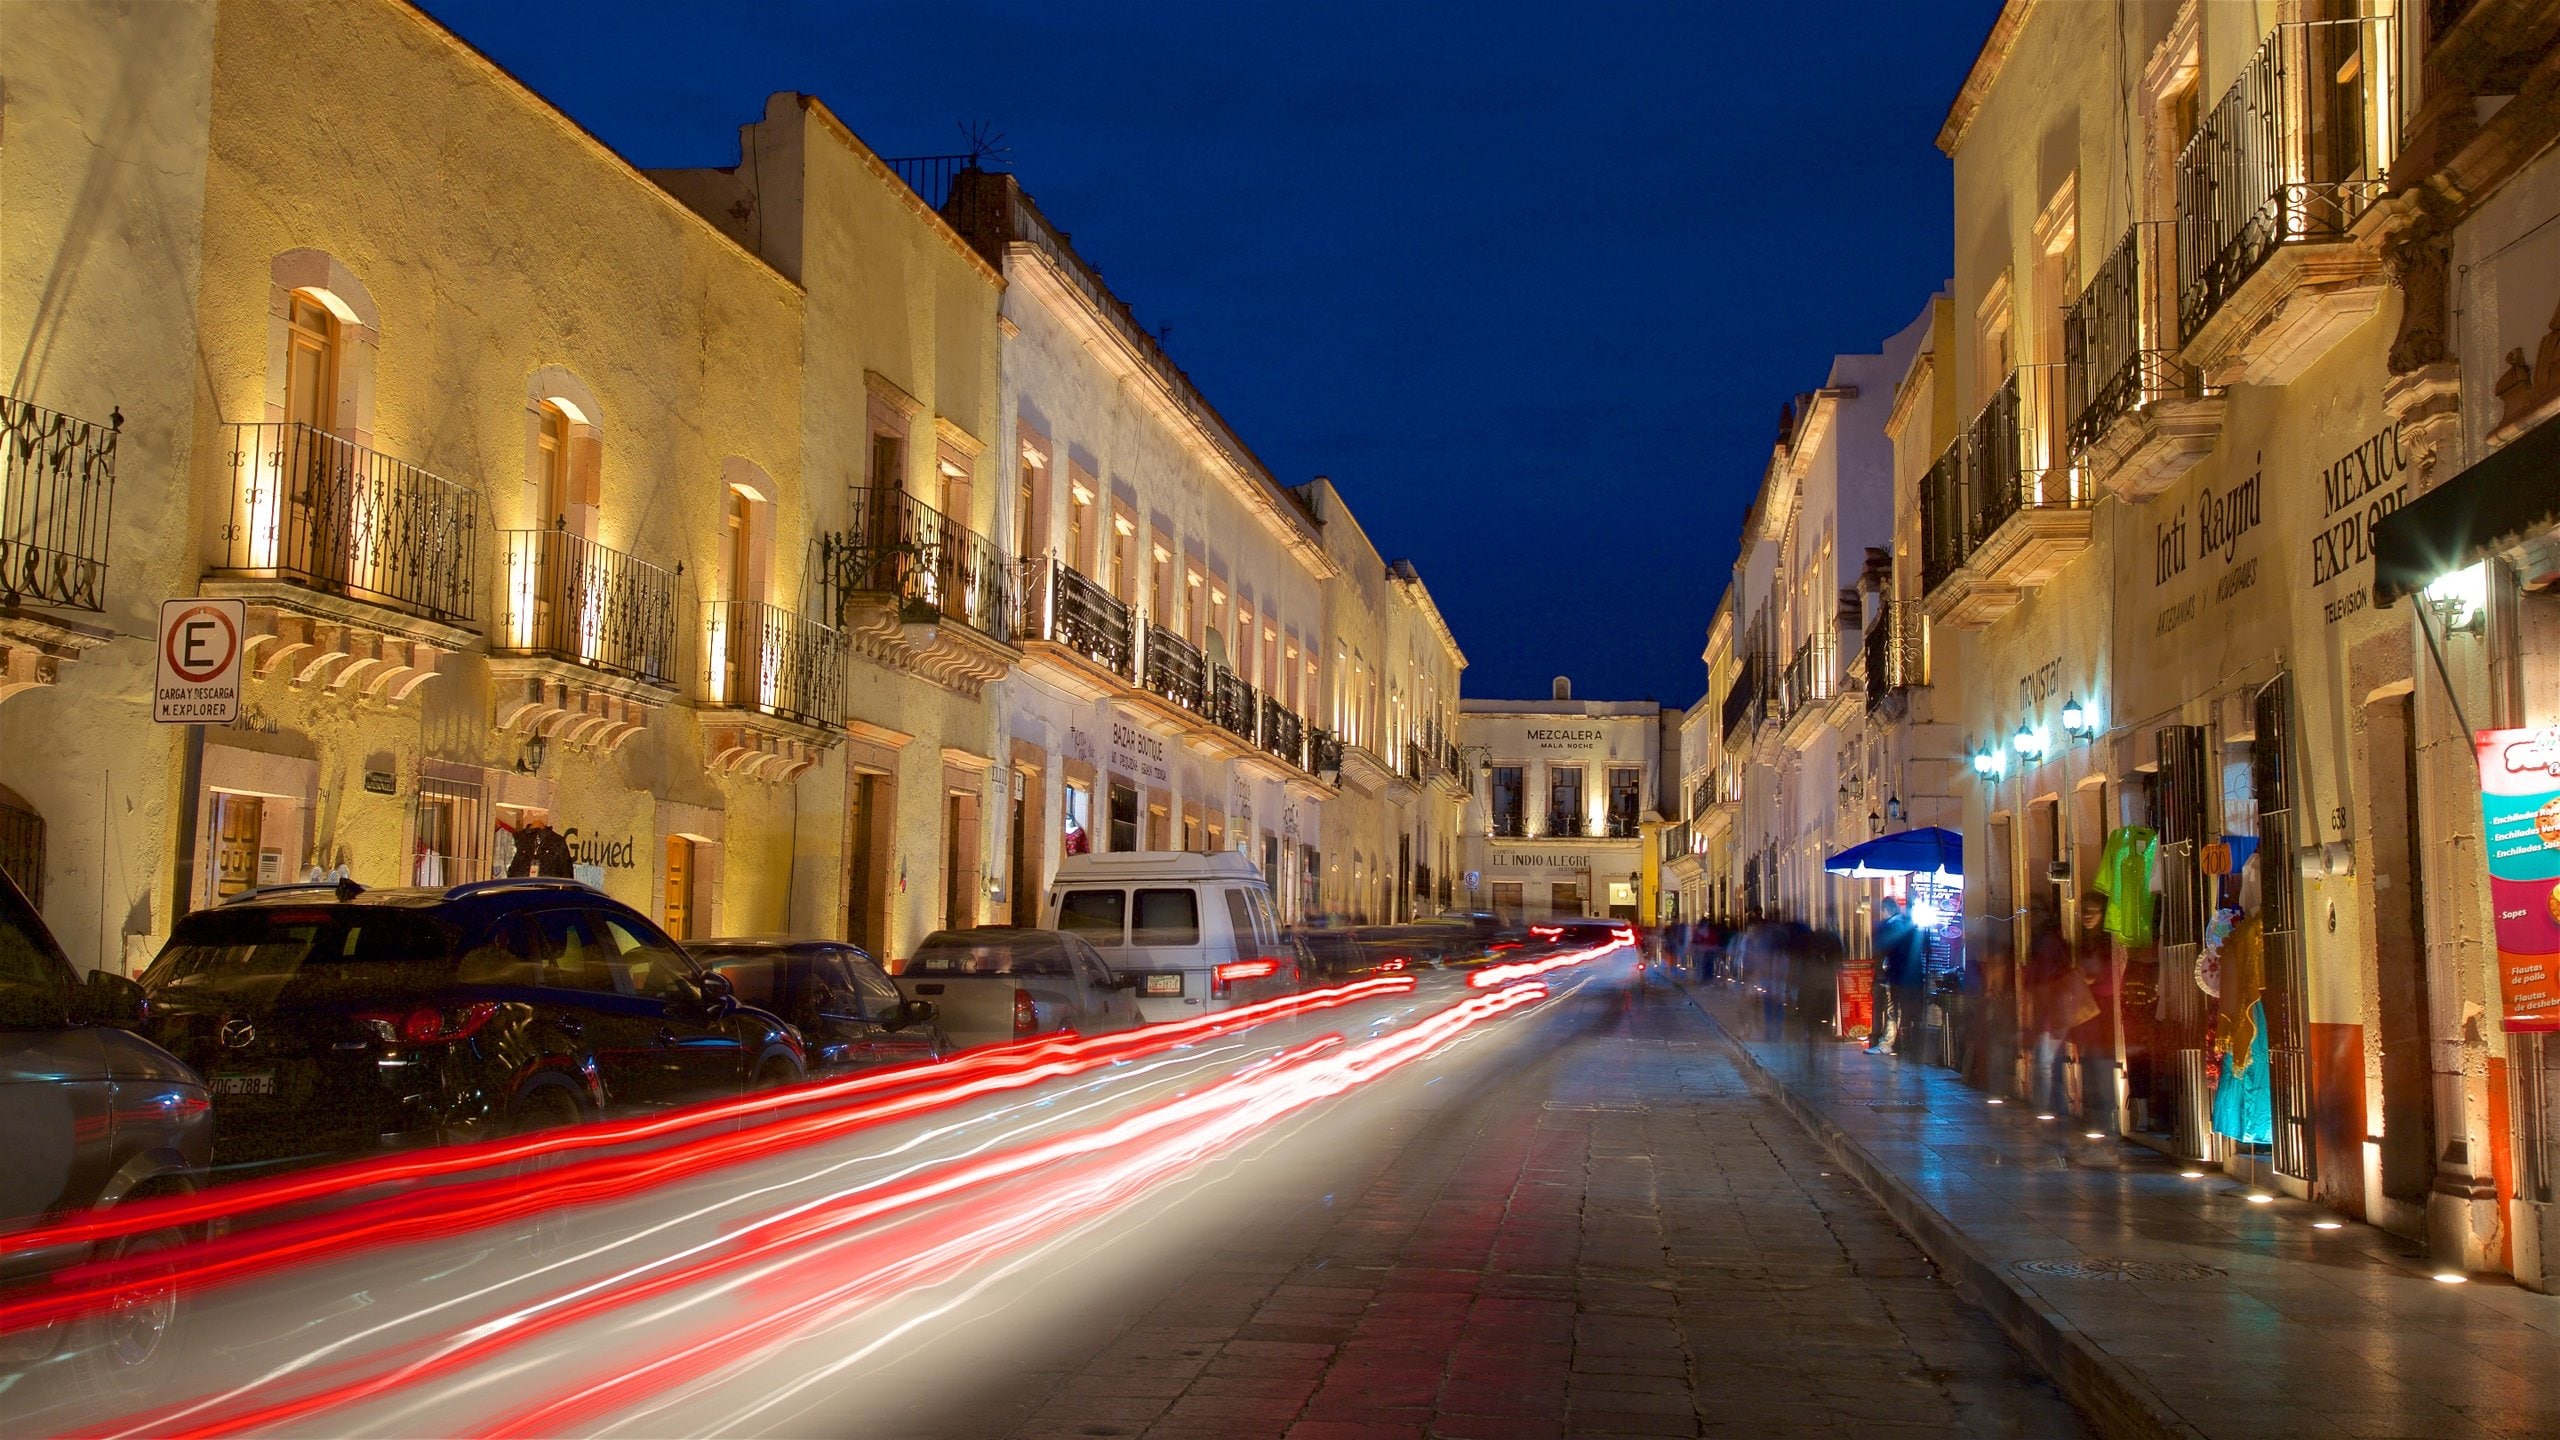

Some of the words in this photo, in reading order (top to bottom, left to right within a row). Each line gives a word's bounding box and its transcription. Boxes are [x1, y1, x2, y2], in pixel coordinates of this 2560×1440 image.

[2155, 504, 2187, 587] Inti
[2199, 450, 2262, 564] Raymi
[2324, 582, 2367, 625] TELEVISIÓN
[184, 622, 215, 667] E
[159, 688, 185, 700] CARGA
[187, 688, 192, 699] Y
[194, 687, 234, 699] DESCARGA
[1527, 729, 1602, 740] MEZCALERA
[1113, 723, 1135, 751] BAZAR
[1138, 734, 1162, 761] BOUTIQUE
[2332, 806, 2346, 830] 638
[2493, 811, 2539, 825] Enchiladas
[2494, 827, 2540, 841] Enchiladas
[2496, 844, 2542, 858] Enchiladas
[1493, 855, 1507, 866] EL
[1512, 855, 1543, 866] INDIO
[1546, 856, 1590, 867] ALEGRE
[2203, 851, 2226, 873] 100
[2502, 909, 2527, 919] Sopes
[2512, 964, 2543, 975] Flautas
[2512, 976, 2522, 984] de
[2523, 972, 2545, 984] pollo
[2514, 991, 2546, 1003] Flautas
[2514, 1003, 2525, 1012] de
